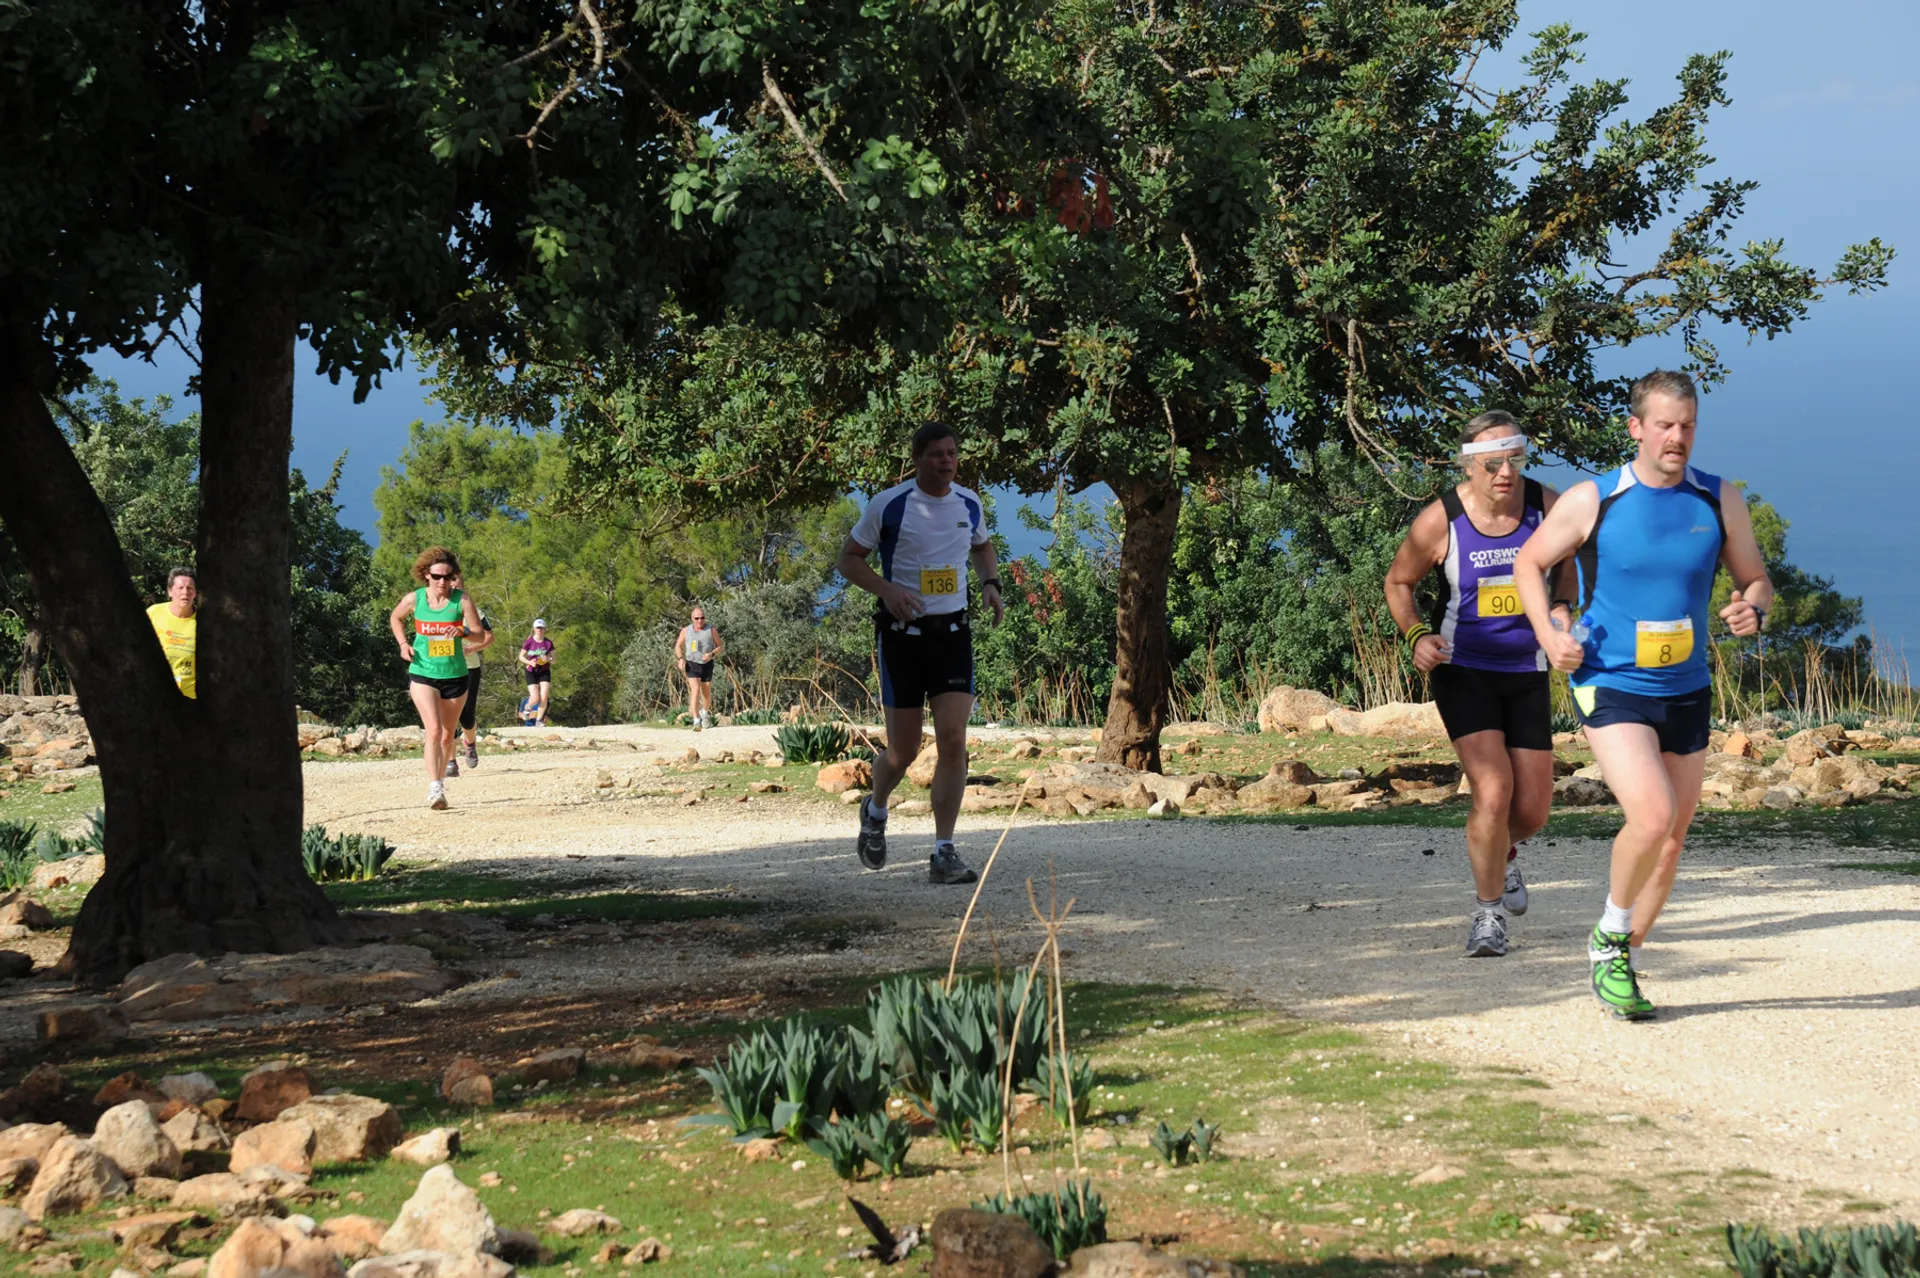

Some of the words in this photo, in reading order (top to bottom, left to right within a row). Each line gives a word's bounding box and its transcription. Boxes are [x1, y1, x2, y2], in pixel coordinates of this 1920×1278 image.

[927, 578, 954, 593] 136
[1492, 595, 1516, 614] 90
[433, 645, 452, 656] 133
[1659, 644, 1672, 664] 8
